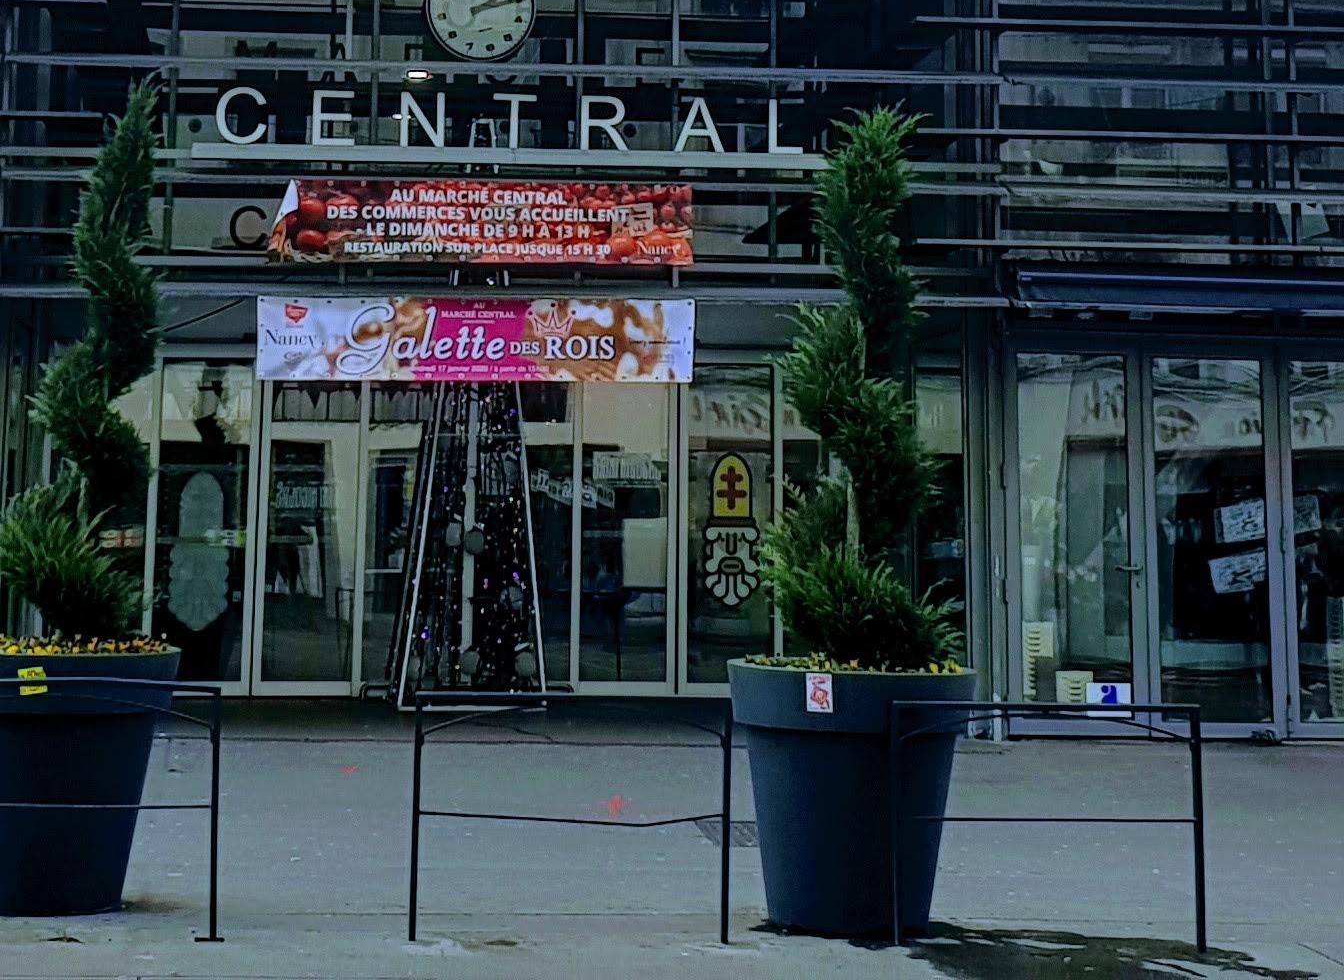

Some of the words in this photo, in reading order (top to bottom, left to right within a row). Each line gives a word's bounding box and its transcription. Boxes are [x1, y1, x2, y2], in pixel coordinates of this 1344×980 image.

[214, 86, 804, 155] CENTRAL
[390, 189, 417, 204] AU
[419, 187, 490, 204] MARCHÉ
[493, 190, 567, 205] CENTRAL
[327, 206, 358, 220] DES
[361, 206, 465, 220] COMMERCES
[470, 207, 516, 221] VOUS
[519, 207, 629, 222] ACCUEILLENT
[367, 222, 385, 236] LE
[387, 222, 482, 237] DIMANCHE
[484, 223, 505, 237] DE
[508, 224, 519, 238] 9
[522, 224, 535, 238] H
[556, 224, 574, 238] 13
[578, 224, 591, 238] H
[344, 242, 443, 254] RESTAURATION
[445, 243, 470, 254] SUR
[473, 242, 512, 254] PLACE
[515, 242, 563, 255] JUSQUE
[566, 243, 581, 254] 15
[583, 243, 594, 255] H
[595, 244, 611, 256] 30
[478, 310, 517, 319] CENTRAL
[336, 302, 506, 374] Galette
[509, 341, 541, 357] DES
[544, 334, 616, 362] ROIS
